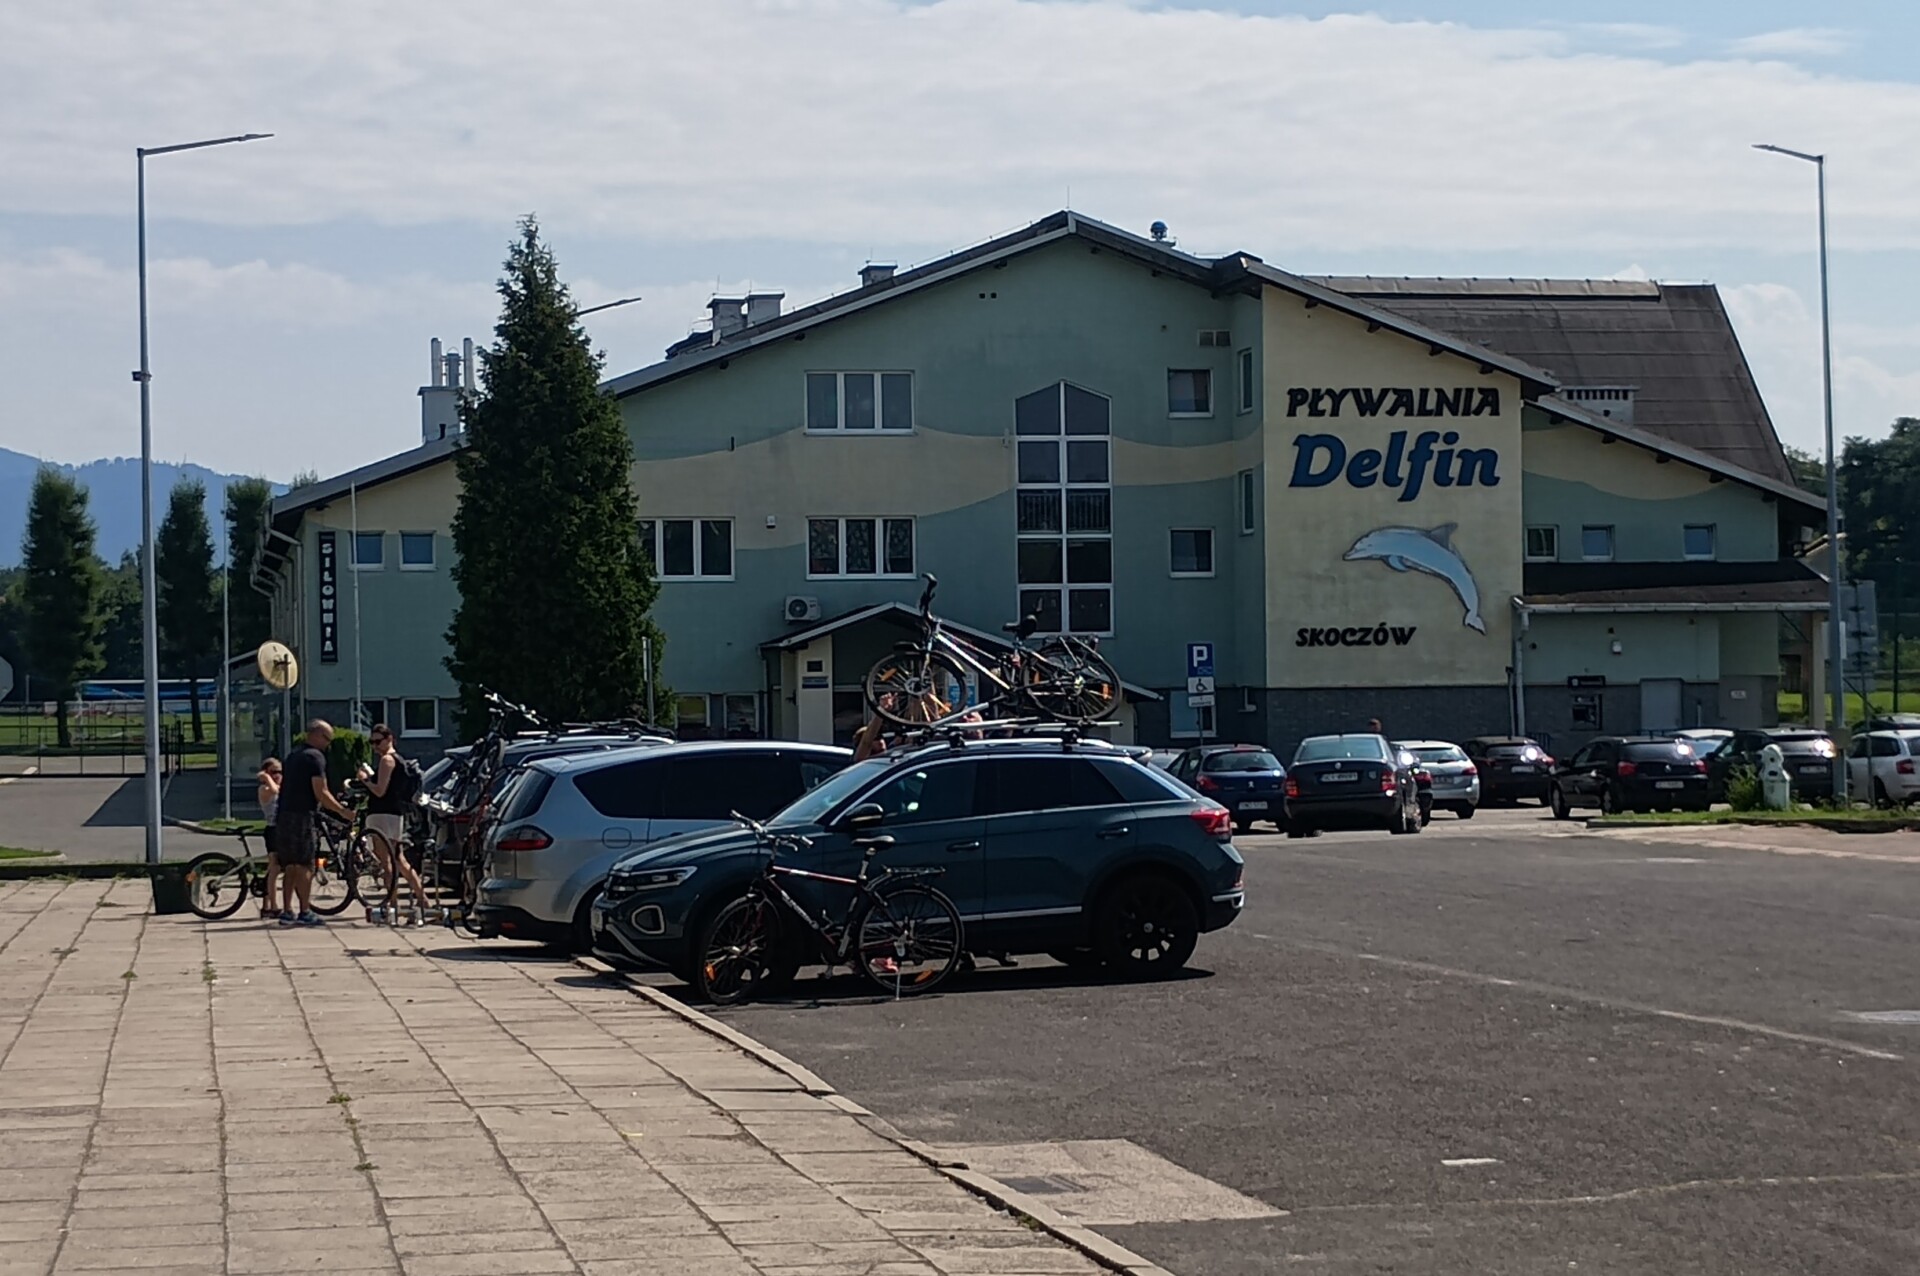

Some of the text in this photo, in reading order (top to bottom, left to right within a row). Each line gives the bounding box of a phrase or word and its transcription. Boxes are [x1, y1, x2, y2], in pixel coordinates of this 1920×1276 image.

[1287, 387, 1500, 418] PŁYWALNIA
[1289, 430, 1500, 502] Delfin
[1295, 622, 1416, 647] SKOCZÓW
[1192, 646, 1208, 668] P
